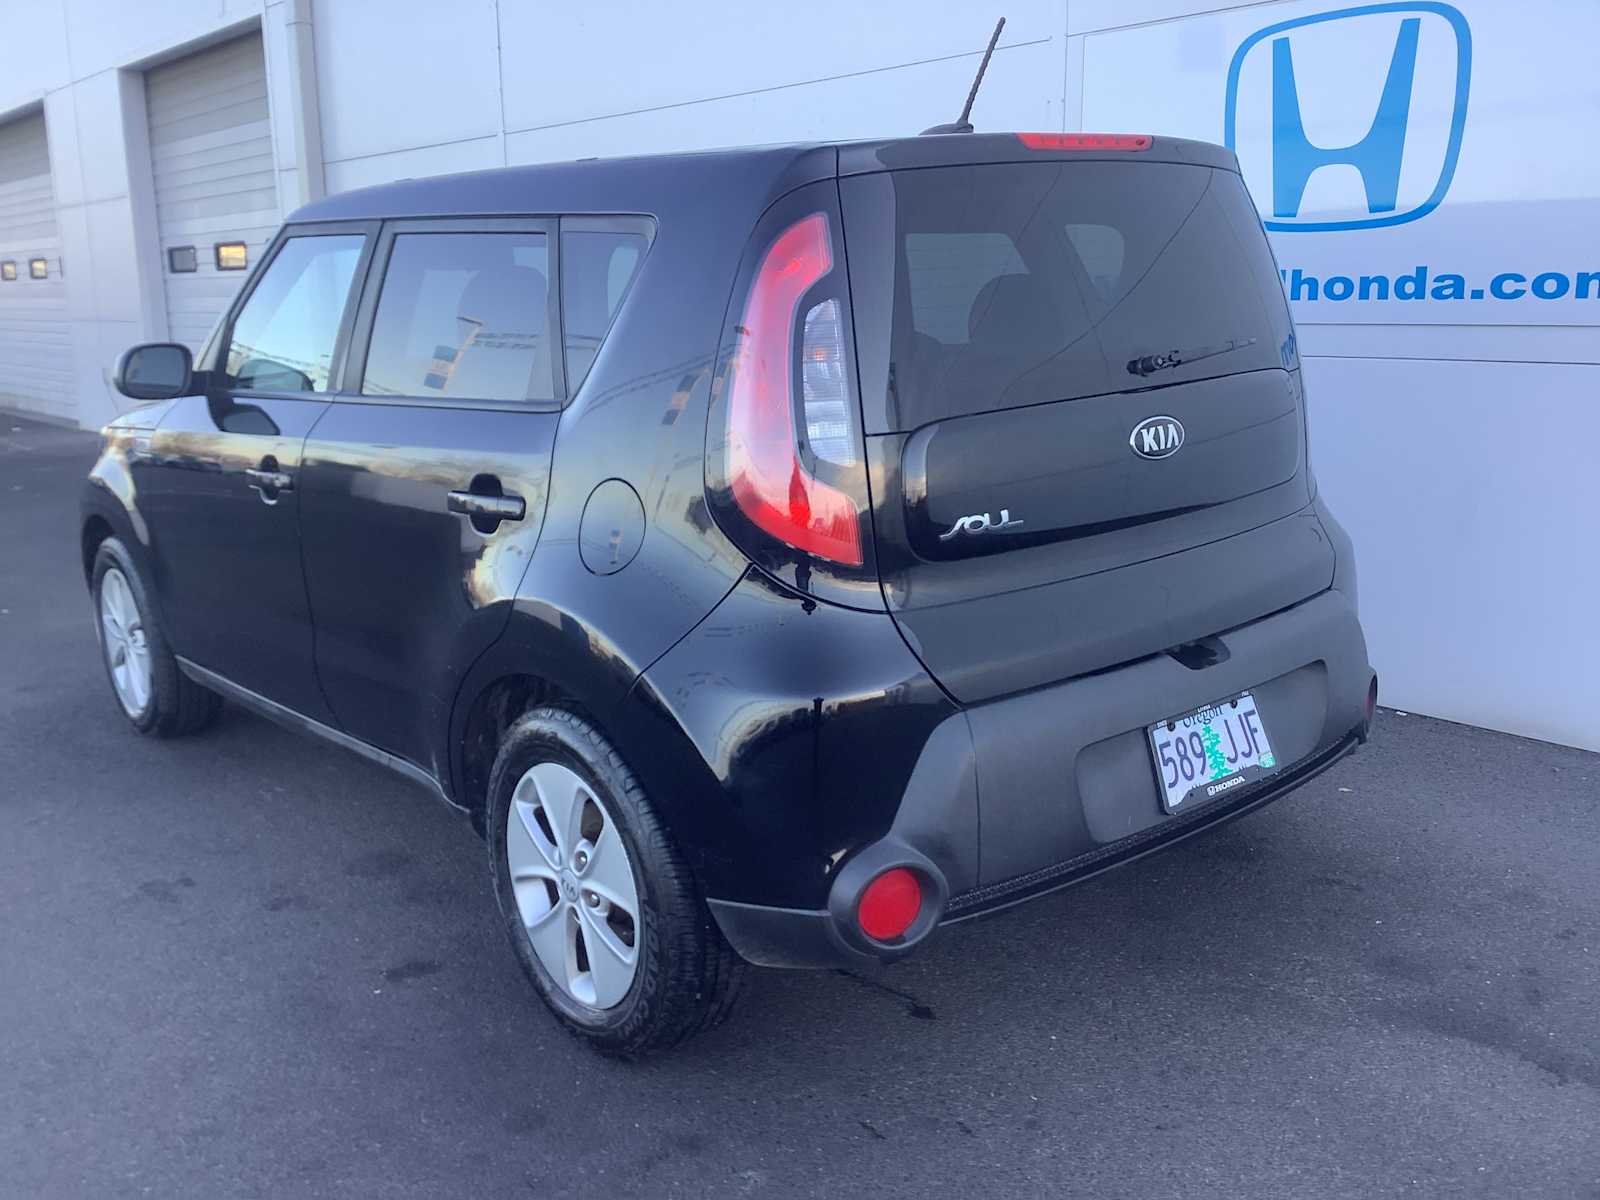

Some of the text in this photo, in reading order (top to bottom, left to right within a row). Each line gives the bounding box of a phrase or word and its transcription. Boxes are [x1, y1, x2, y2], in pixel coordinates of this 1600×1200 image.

[1280, 266, 1600, 301] honda.co
[1140, 424, 1179, 453] KIA
[1158, 709, 1261, 789] 589 JJF
[1214, 776, 1246, 793] HONDA
